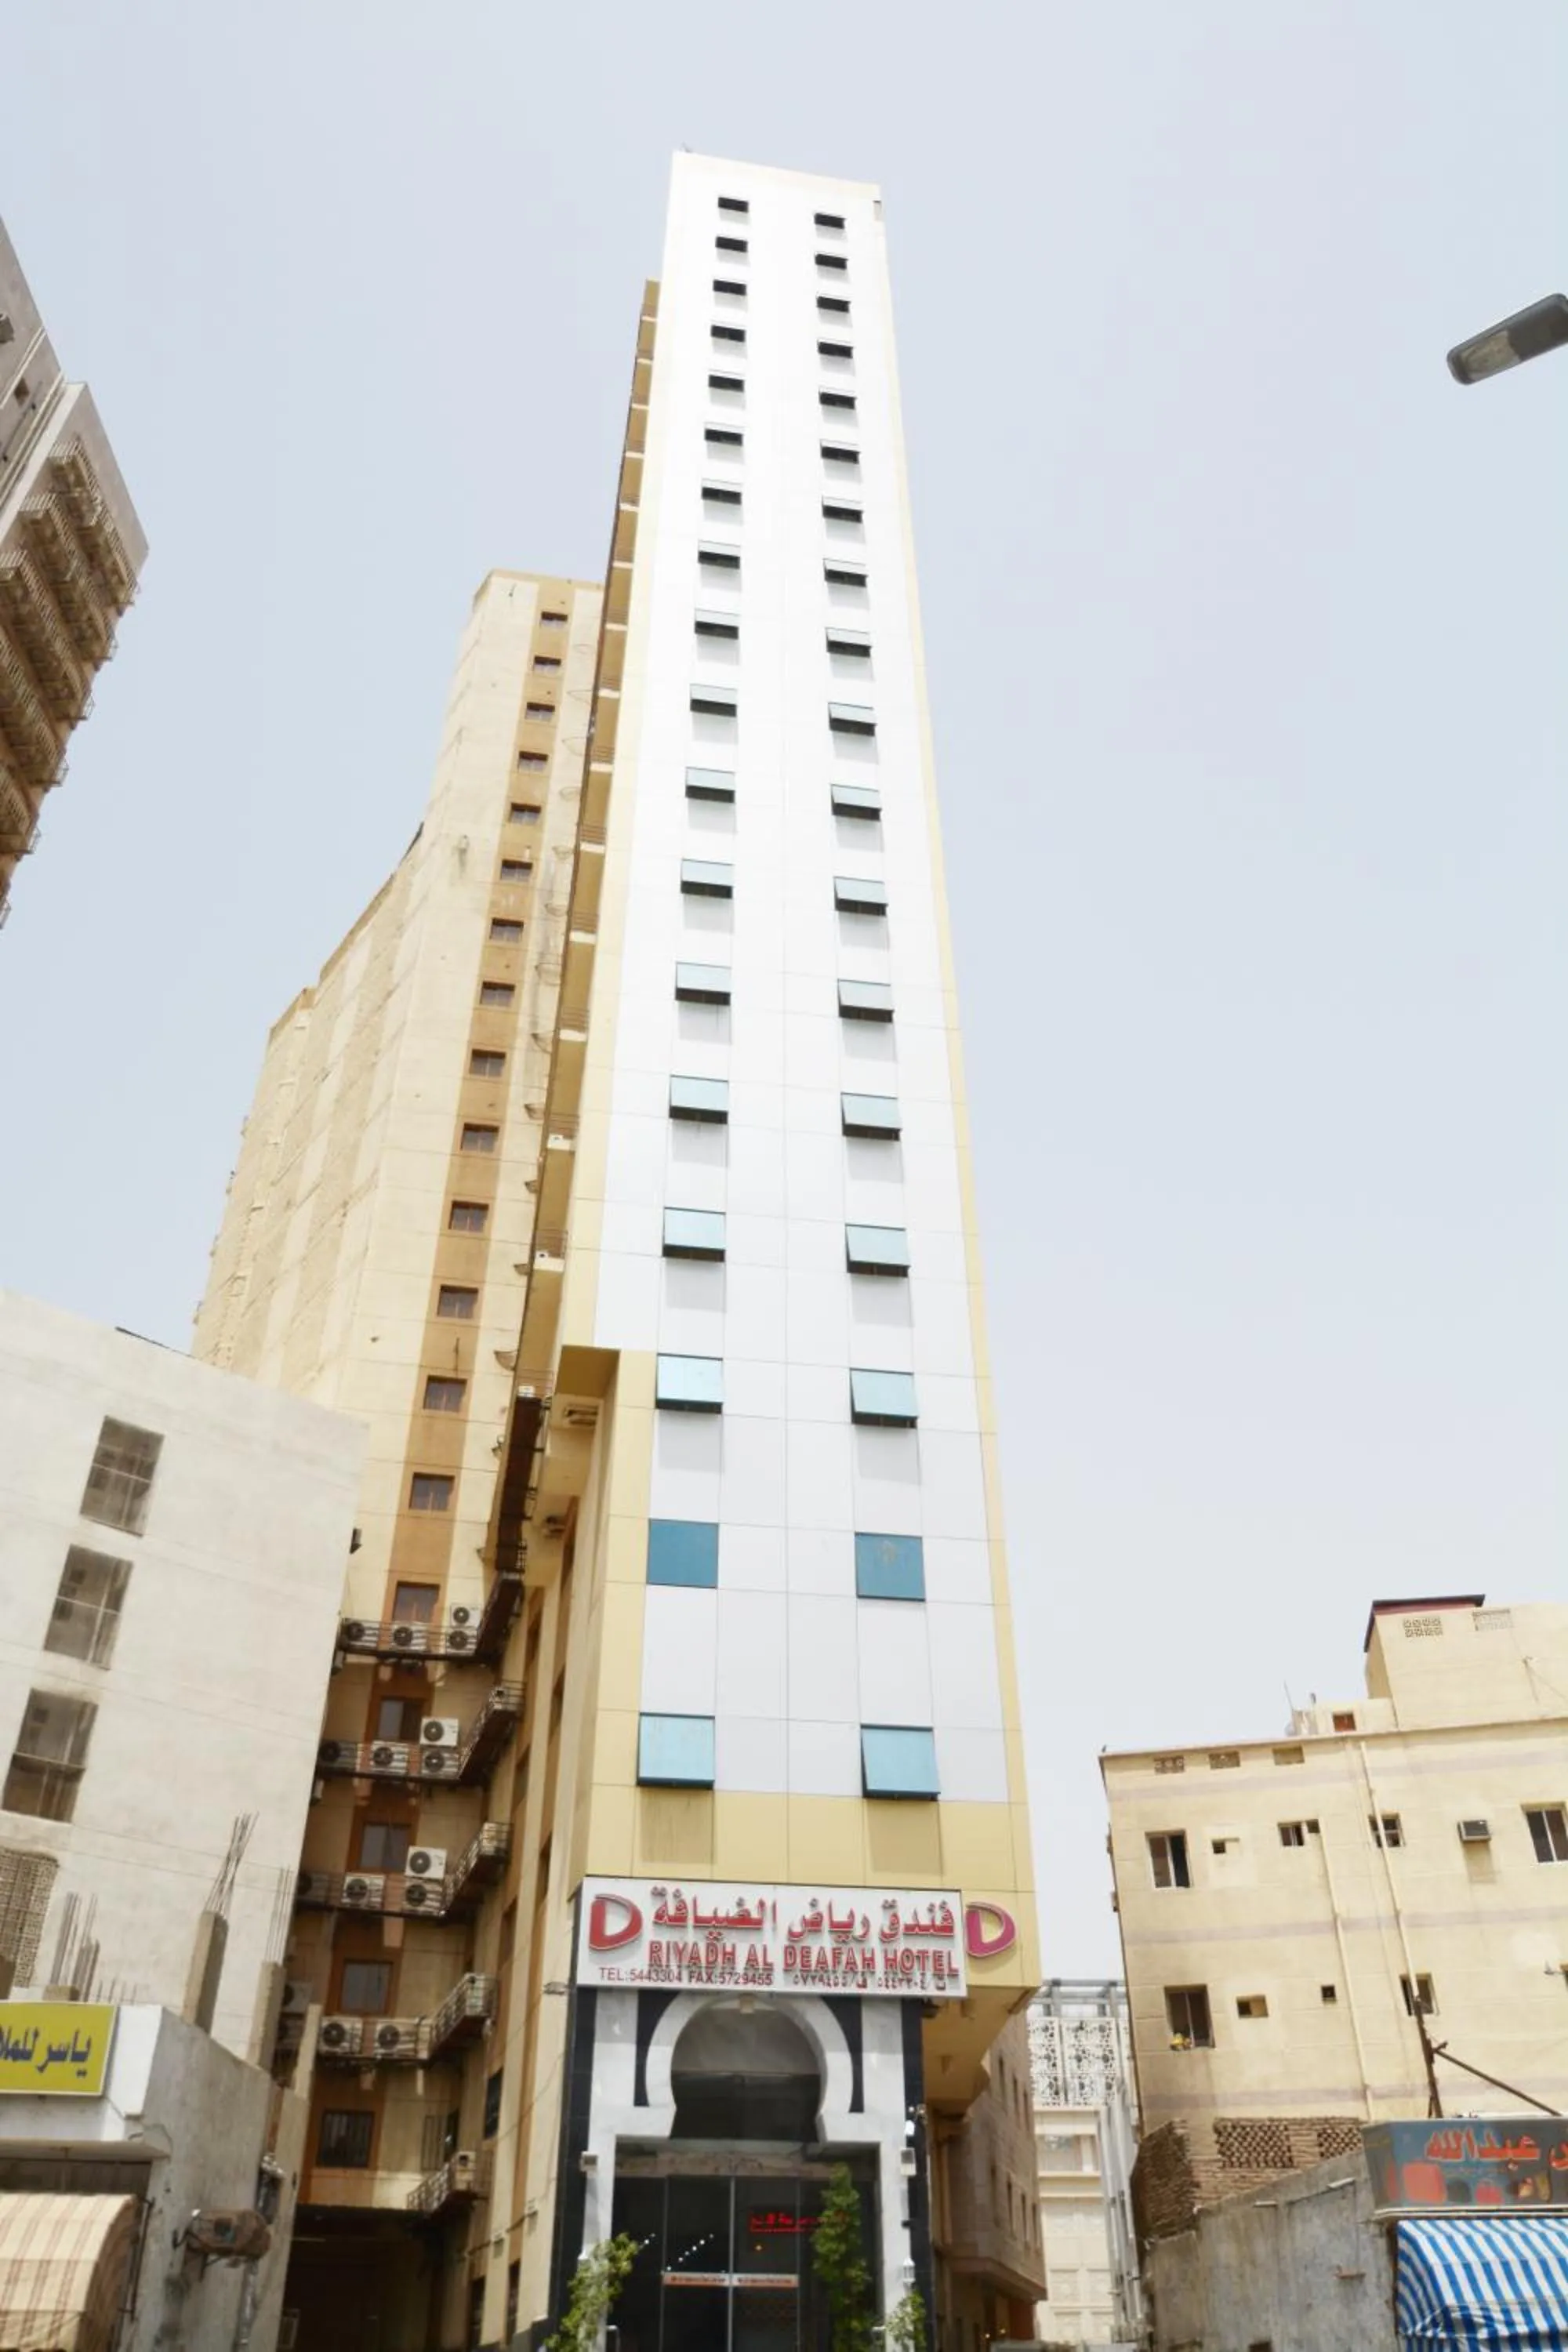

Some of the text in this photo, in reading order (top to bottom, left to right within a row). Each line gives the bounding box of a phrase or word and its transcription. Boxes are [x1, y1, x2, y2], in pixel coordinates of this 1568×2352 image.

[651, 1886, 954, 1944] فندق رياض الضيافة
[648, 1940, 960, 1976] RIYADH AL DEAFAH HOTEL
[37, 2027, 92, 2078] ياسر
